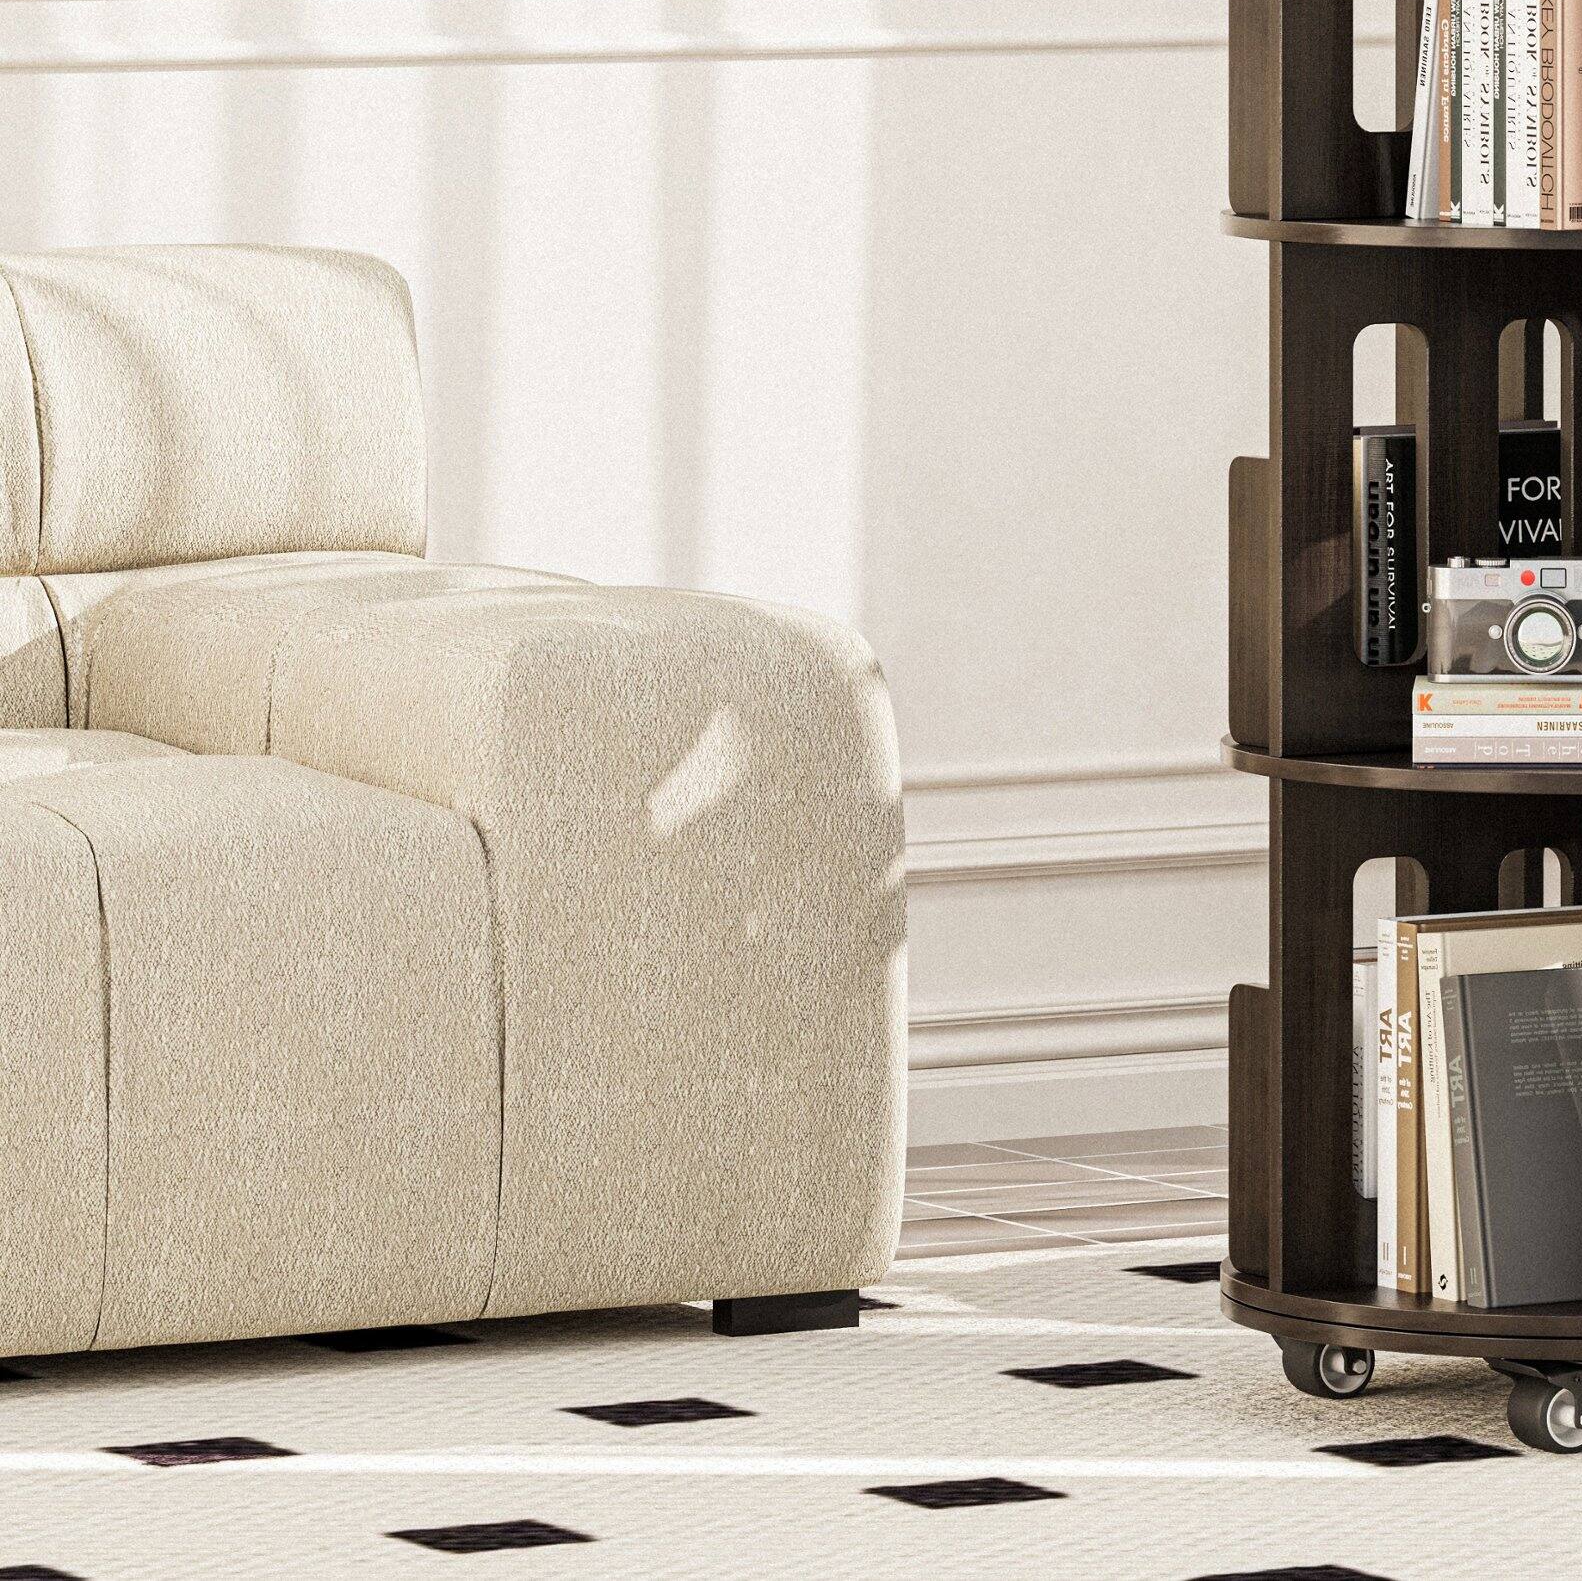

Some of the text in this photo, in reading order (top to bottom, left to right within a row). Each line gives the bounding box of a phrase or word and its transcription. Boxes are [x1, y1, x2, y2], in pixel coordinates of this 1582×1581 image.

[1385, 458, 1394, 495] ART
[1507, 476, 1562, 502] FOR
[1385, 501, 1395, 539] FOR
